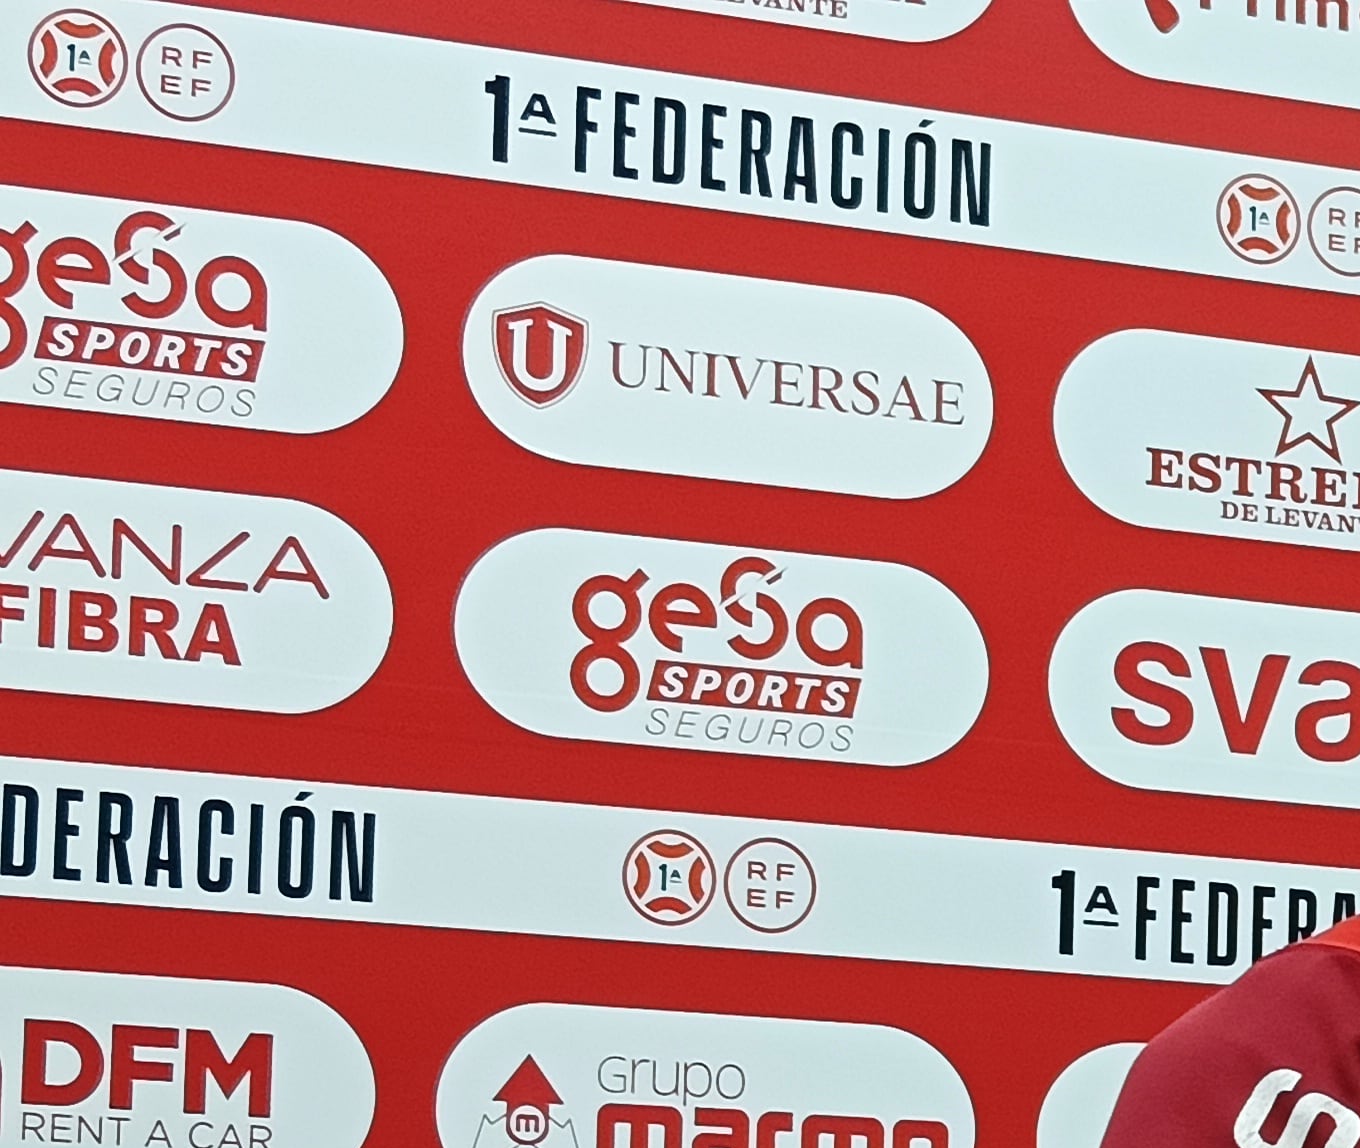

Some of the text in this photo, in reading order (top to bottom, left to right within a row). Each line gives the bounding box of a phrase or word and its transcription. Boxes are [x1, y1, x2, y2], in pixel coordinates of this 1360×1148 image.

[47, 323, 255, 377] SPORTS
[33, 366, 257, 419] SEGUROS
[609, 342, 966, 427] UNIVERSAE
[1220, 501, 1260, 523] DE
[0, 583, 242, 667] FIBRA
[658, 664, 850, 713] SPORTS
[645, 707, 854, 754] SEGUROS
[21, 1019, 273, 1119] DFM
[597, 1055, 746, 1106] Grupo
[21, 1111, 131, 1148] RENT
[145, 1119, 172, 1148] A
